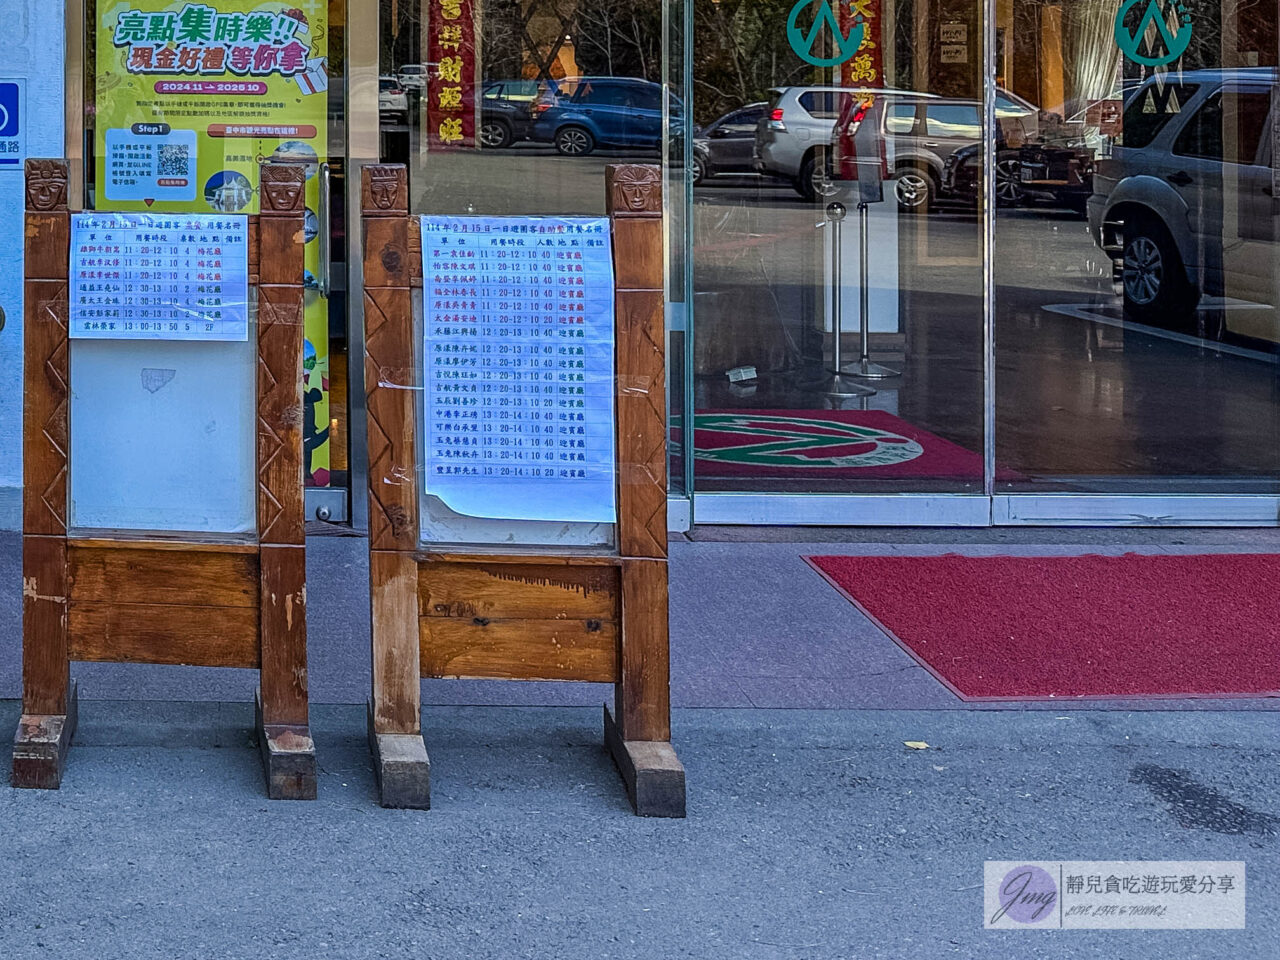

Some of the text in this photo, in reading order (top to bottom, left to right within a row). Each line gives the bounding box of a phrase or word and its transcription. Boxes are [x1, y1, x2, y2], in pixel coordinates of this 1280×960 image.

[131, 42, 308, 71] 現金好禮 等你拿
[185, 323, 190, 331] 5
